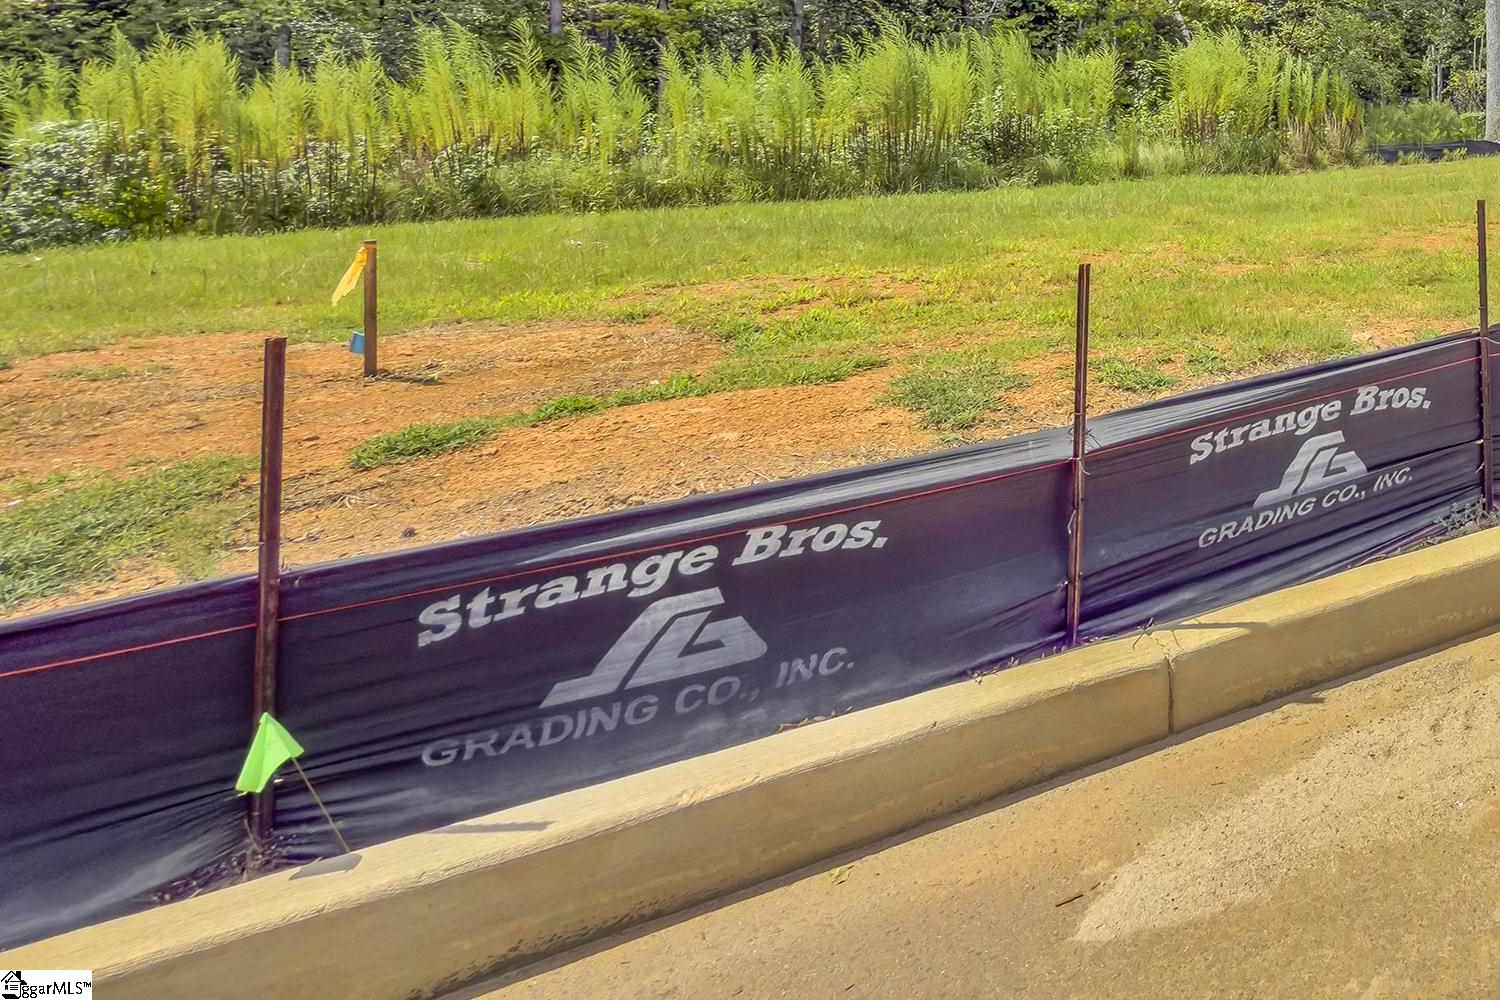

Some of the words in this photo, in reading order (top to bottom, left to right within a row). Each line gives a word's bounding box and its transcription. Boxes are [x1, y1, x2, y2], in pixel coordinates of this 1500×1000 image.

[1190, 399, 1341, 464] Strange
[1350, 386, 1431, 415] Bros.
[1198, 498, 1316, 548] GRADING
[1322, 483, 1366, 508] CO.,
[1373, 467, 1413, 491] INC.
[417, 544, 719, 648] Strange
[732, 520, 889, 567] Bros.
[421, 695, 659, 767] GRADING
[675, 676, 760, 715] CO.,
[775, 647, 854, 688] INC.
